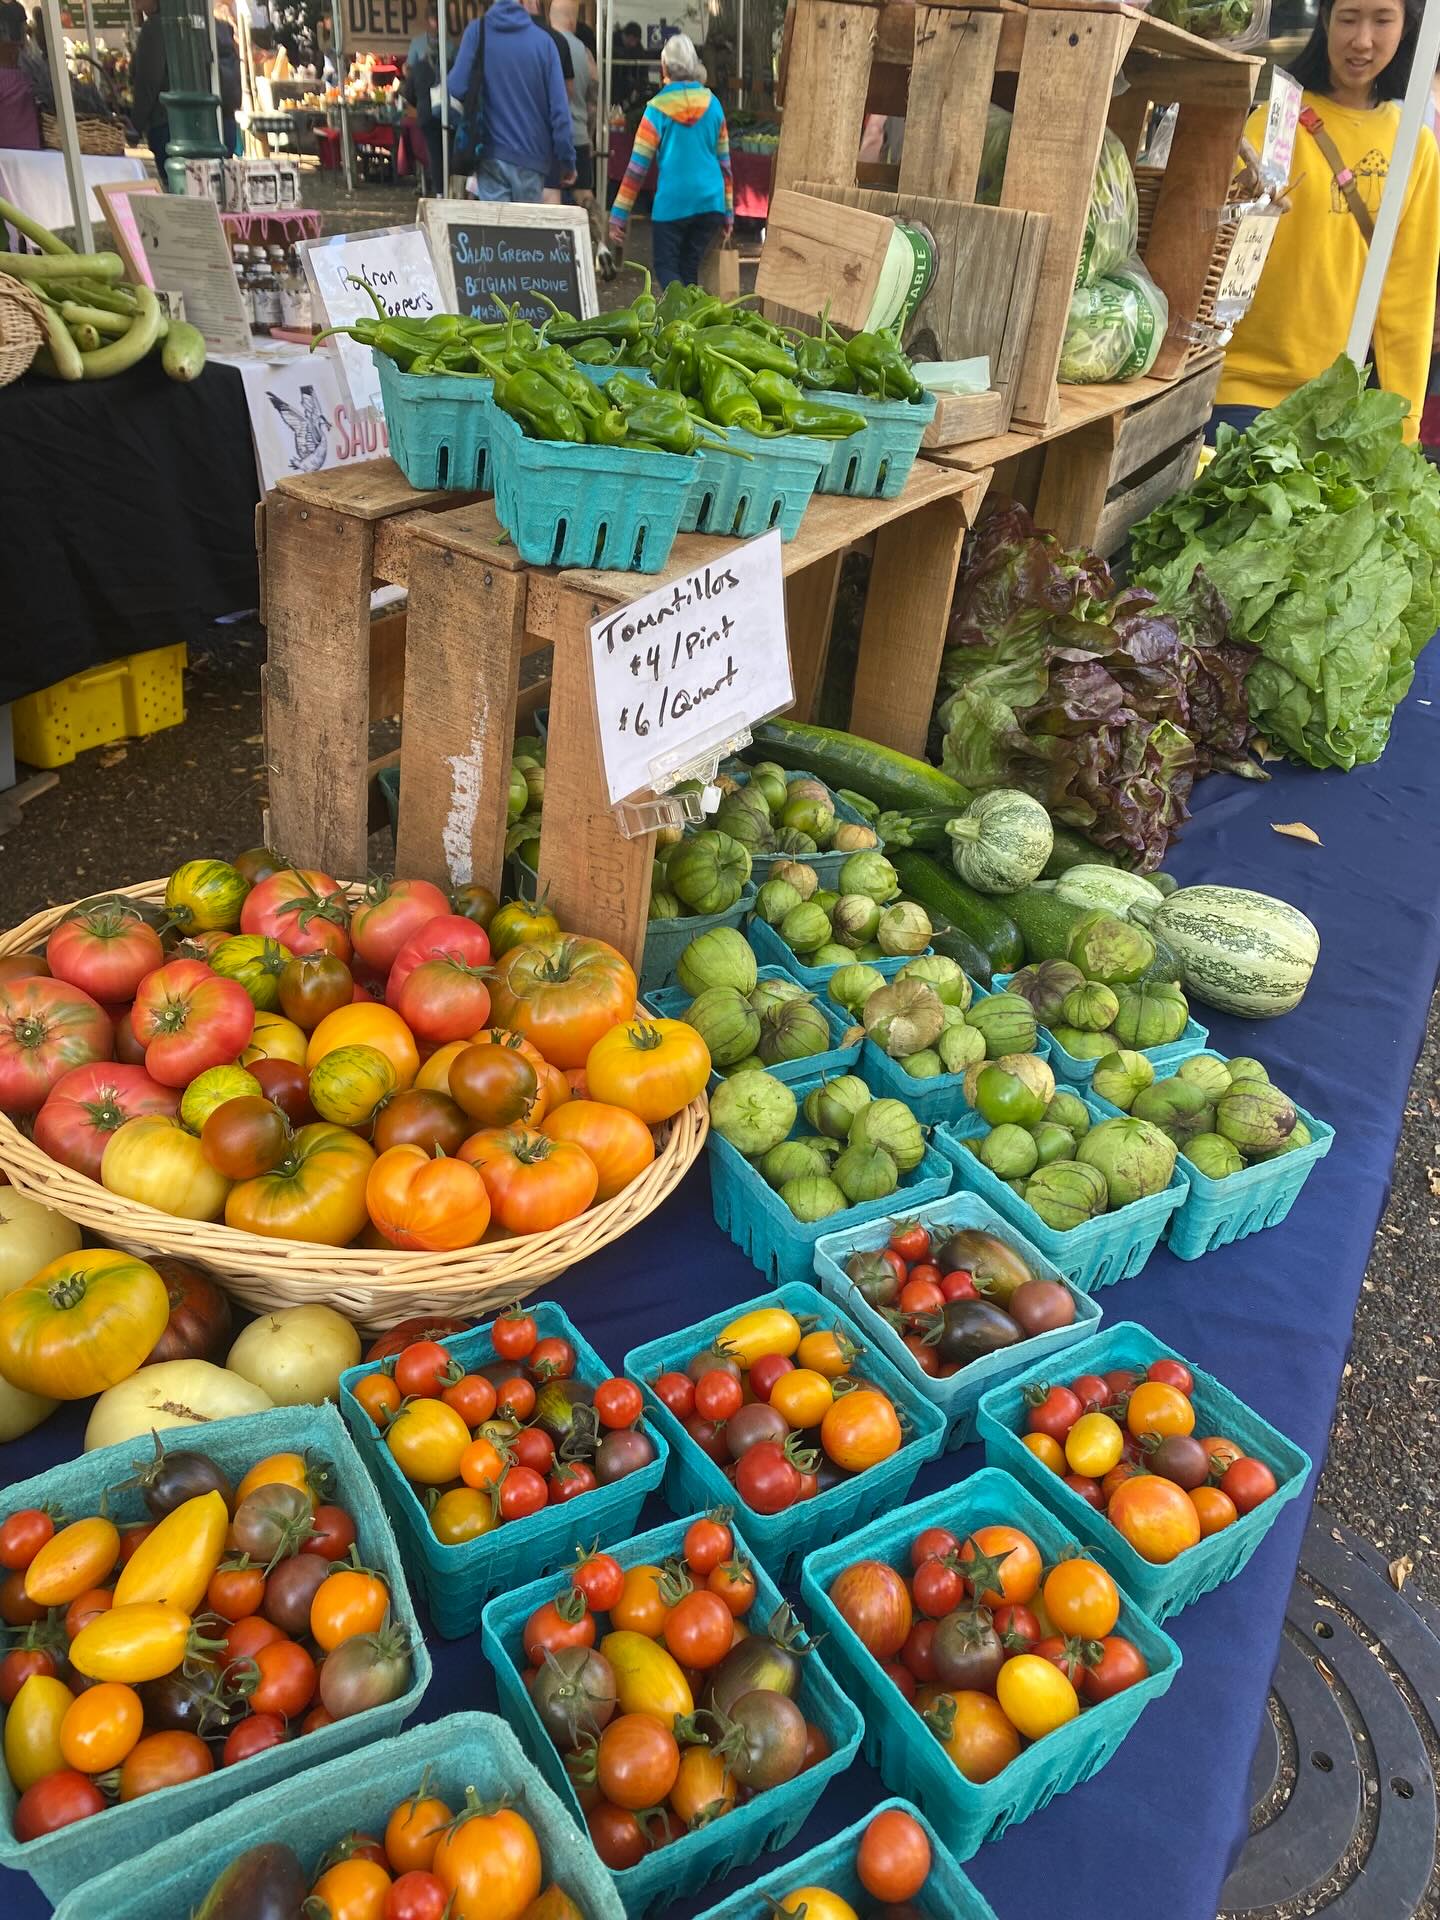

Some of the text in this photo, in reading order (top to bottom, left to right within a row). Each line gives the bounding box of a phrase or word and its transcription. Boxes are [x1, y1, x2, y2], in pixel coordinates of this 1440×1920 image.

[350, 0, 417, 34] DEEP
[456, 232, 493, 264] SALAD
[498, 240, 545, 263] GREENS
[465, 275, 569, 296] BELGIAN ENDIVE
[470, 303, 548, 320] MUSHOOMS
